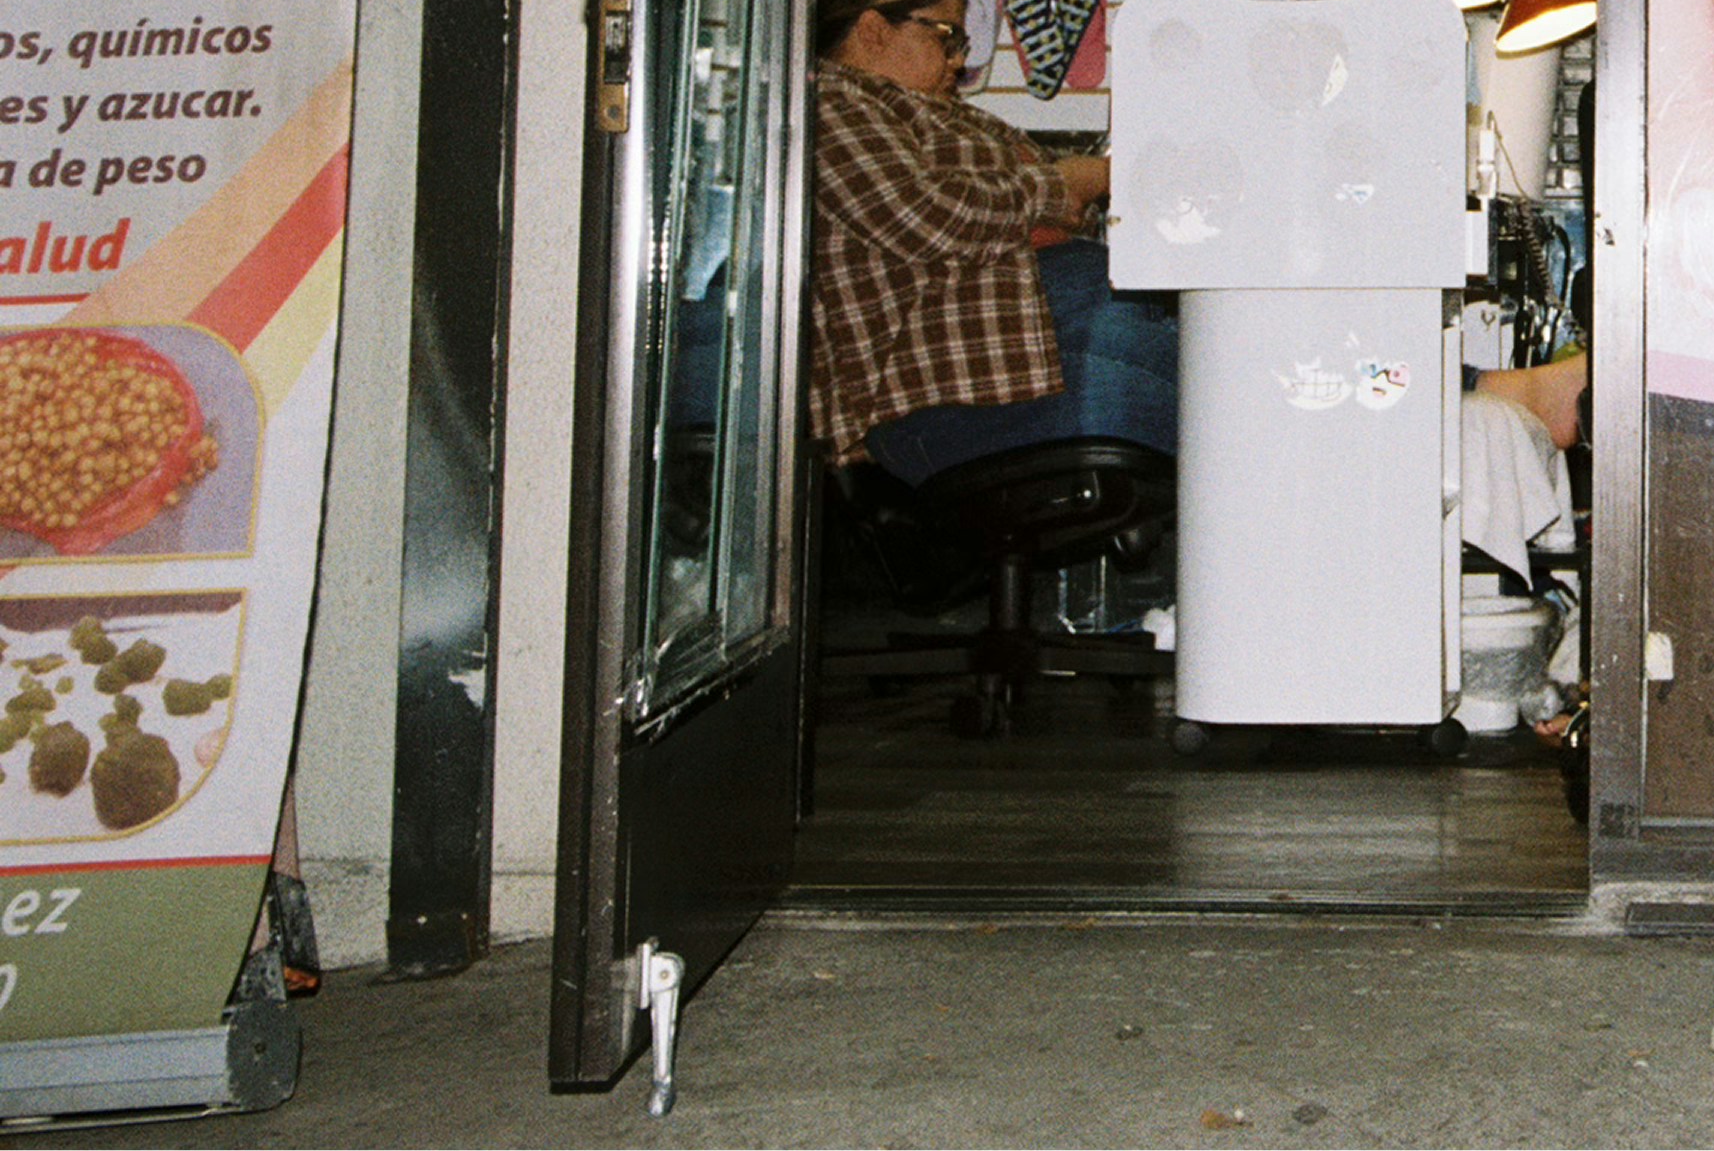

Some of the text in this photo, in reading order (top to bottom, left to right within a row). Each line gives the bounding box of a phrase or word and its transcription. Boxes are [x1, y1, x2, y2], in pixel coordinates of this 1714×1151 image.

[68, 17, 272, 69] químicos
[0, 87, 262, 135] es y azucar.
[28, 148, 87, 188] de
[93, 152, 207, 196] peso
[2, 888, 81, 937] ez
